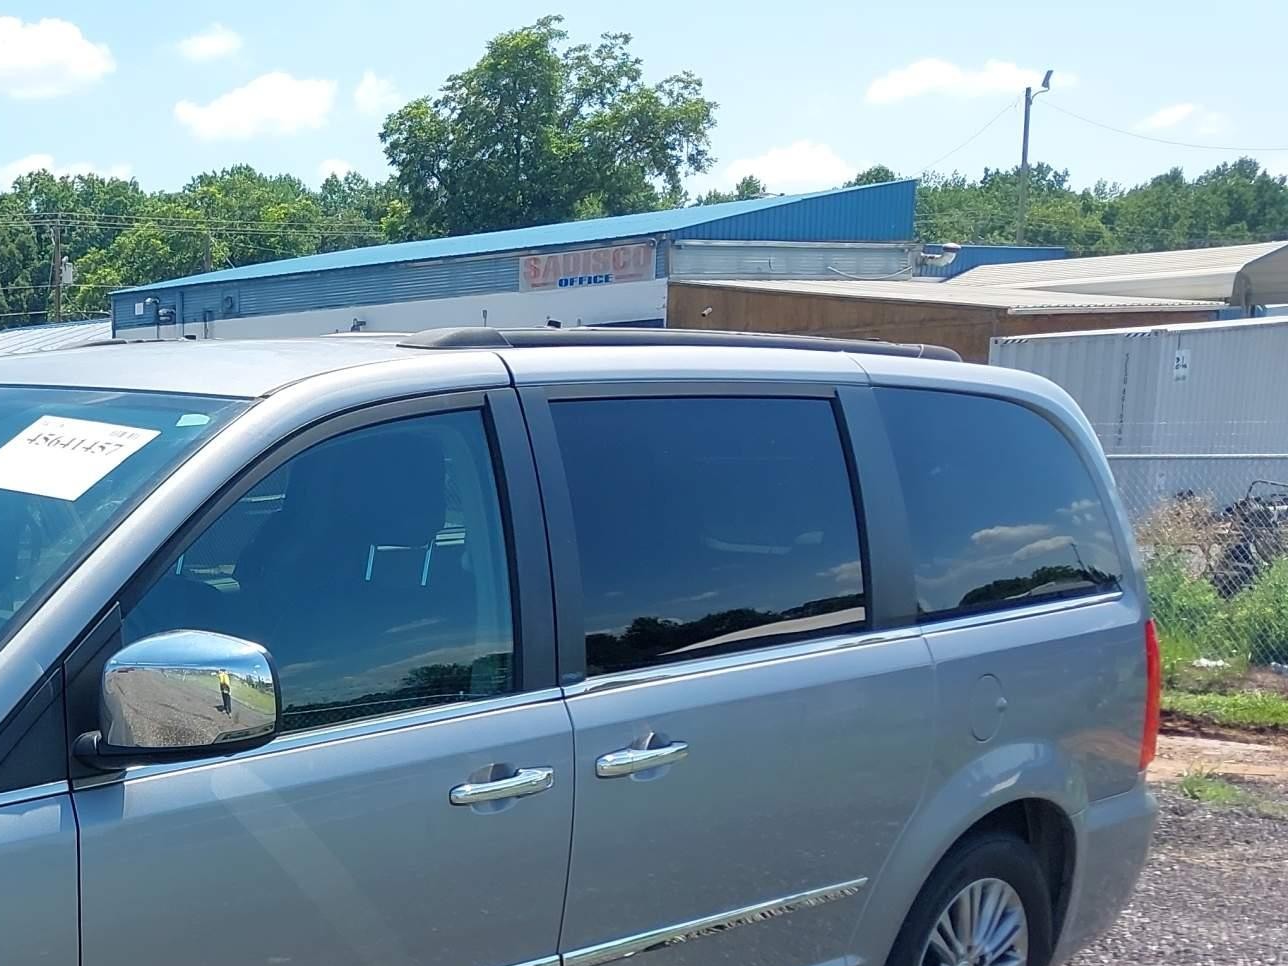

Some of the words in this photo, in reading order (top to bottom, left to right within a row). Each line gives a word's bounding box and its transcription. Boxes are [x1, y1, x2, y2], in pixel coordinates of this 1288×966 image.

[524, 246, 652, 281] SADISCO
[558, 273, 613, 288] OFFICE
[26, 433, 124, 456] 45641457
